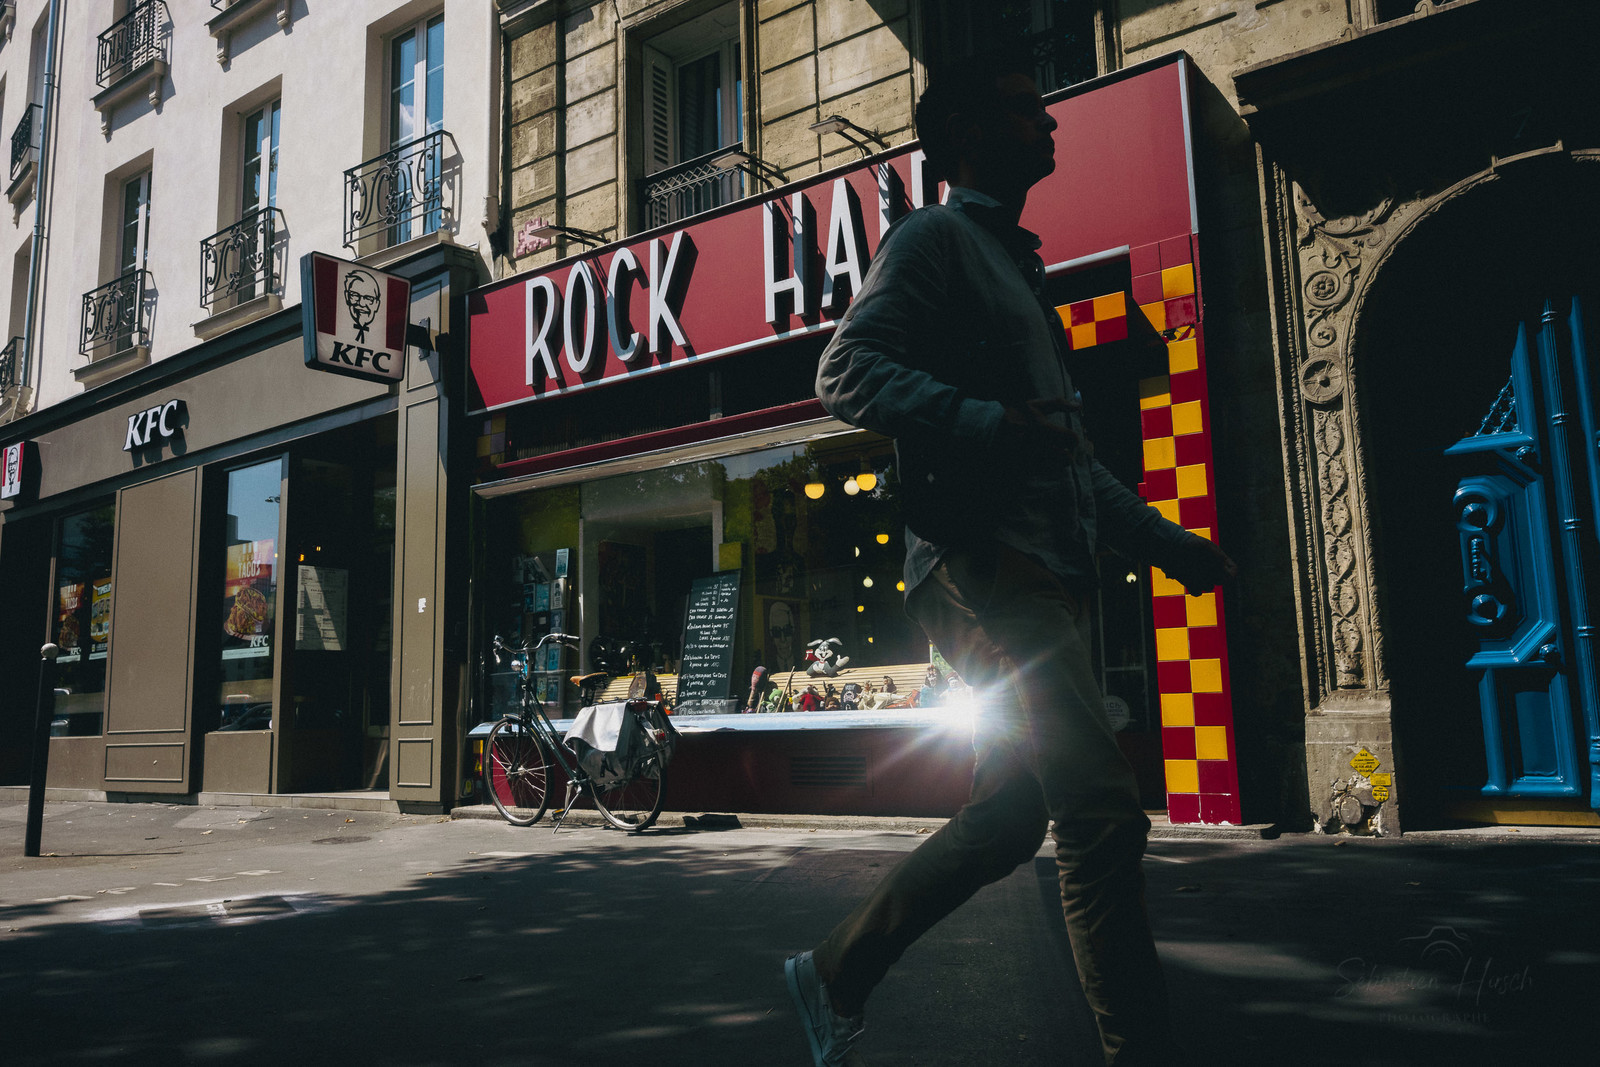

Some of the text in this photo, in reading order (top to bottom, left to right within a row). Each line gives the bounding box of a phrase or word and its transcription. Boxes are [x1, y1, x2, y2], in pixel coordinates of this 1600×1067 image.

[525, 149, 952, 387] ROCK HAI
[329, 341, 392, 373] KFC
[123, 399, 178, 451] KFC
[238, 560, 261, 579] TACOS
[250, 635, 269, 648] KFC
